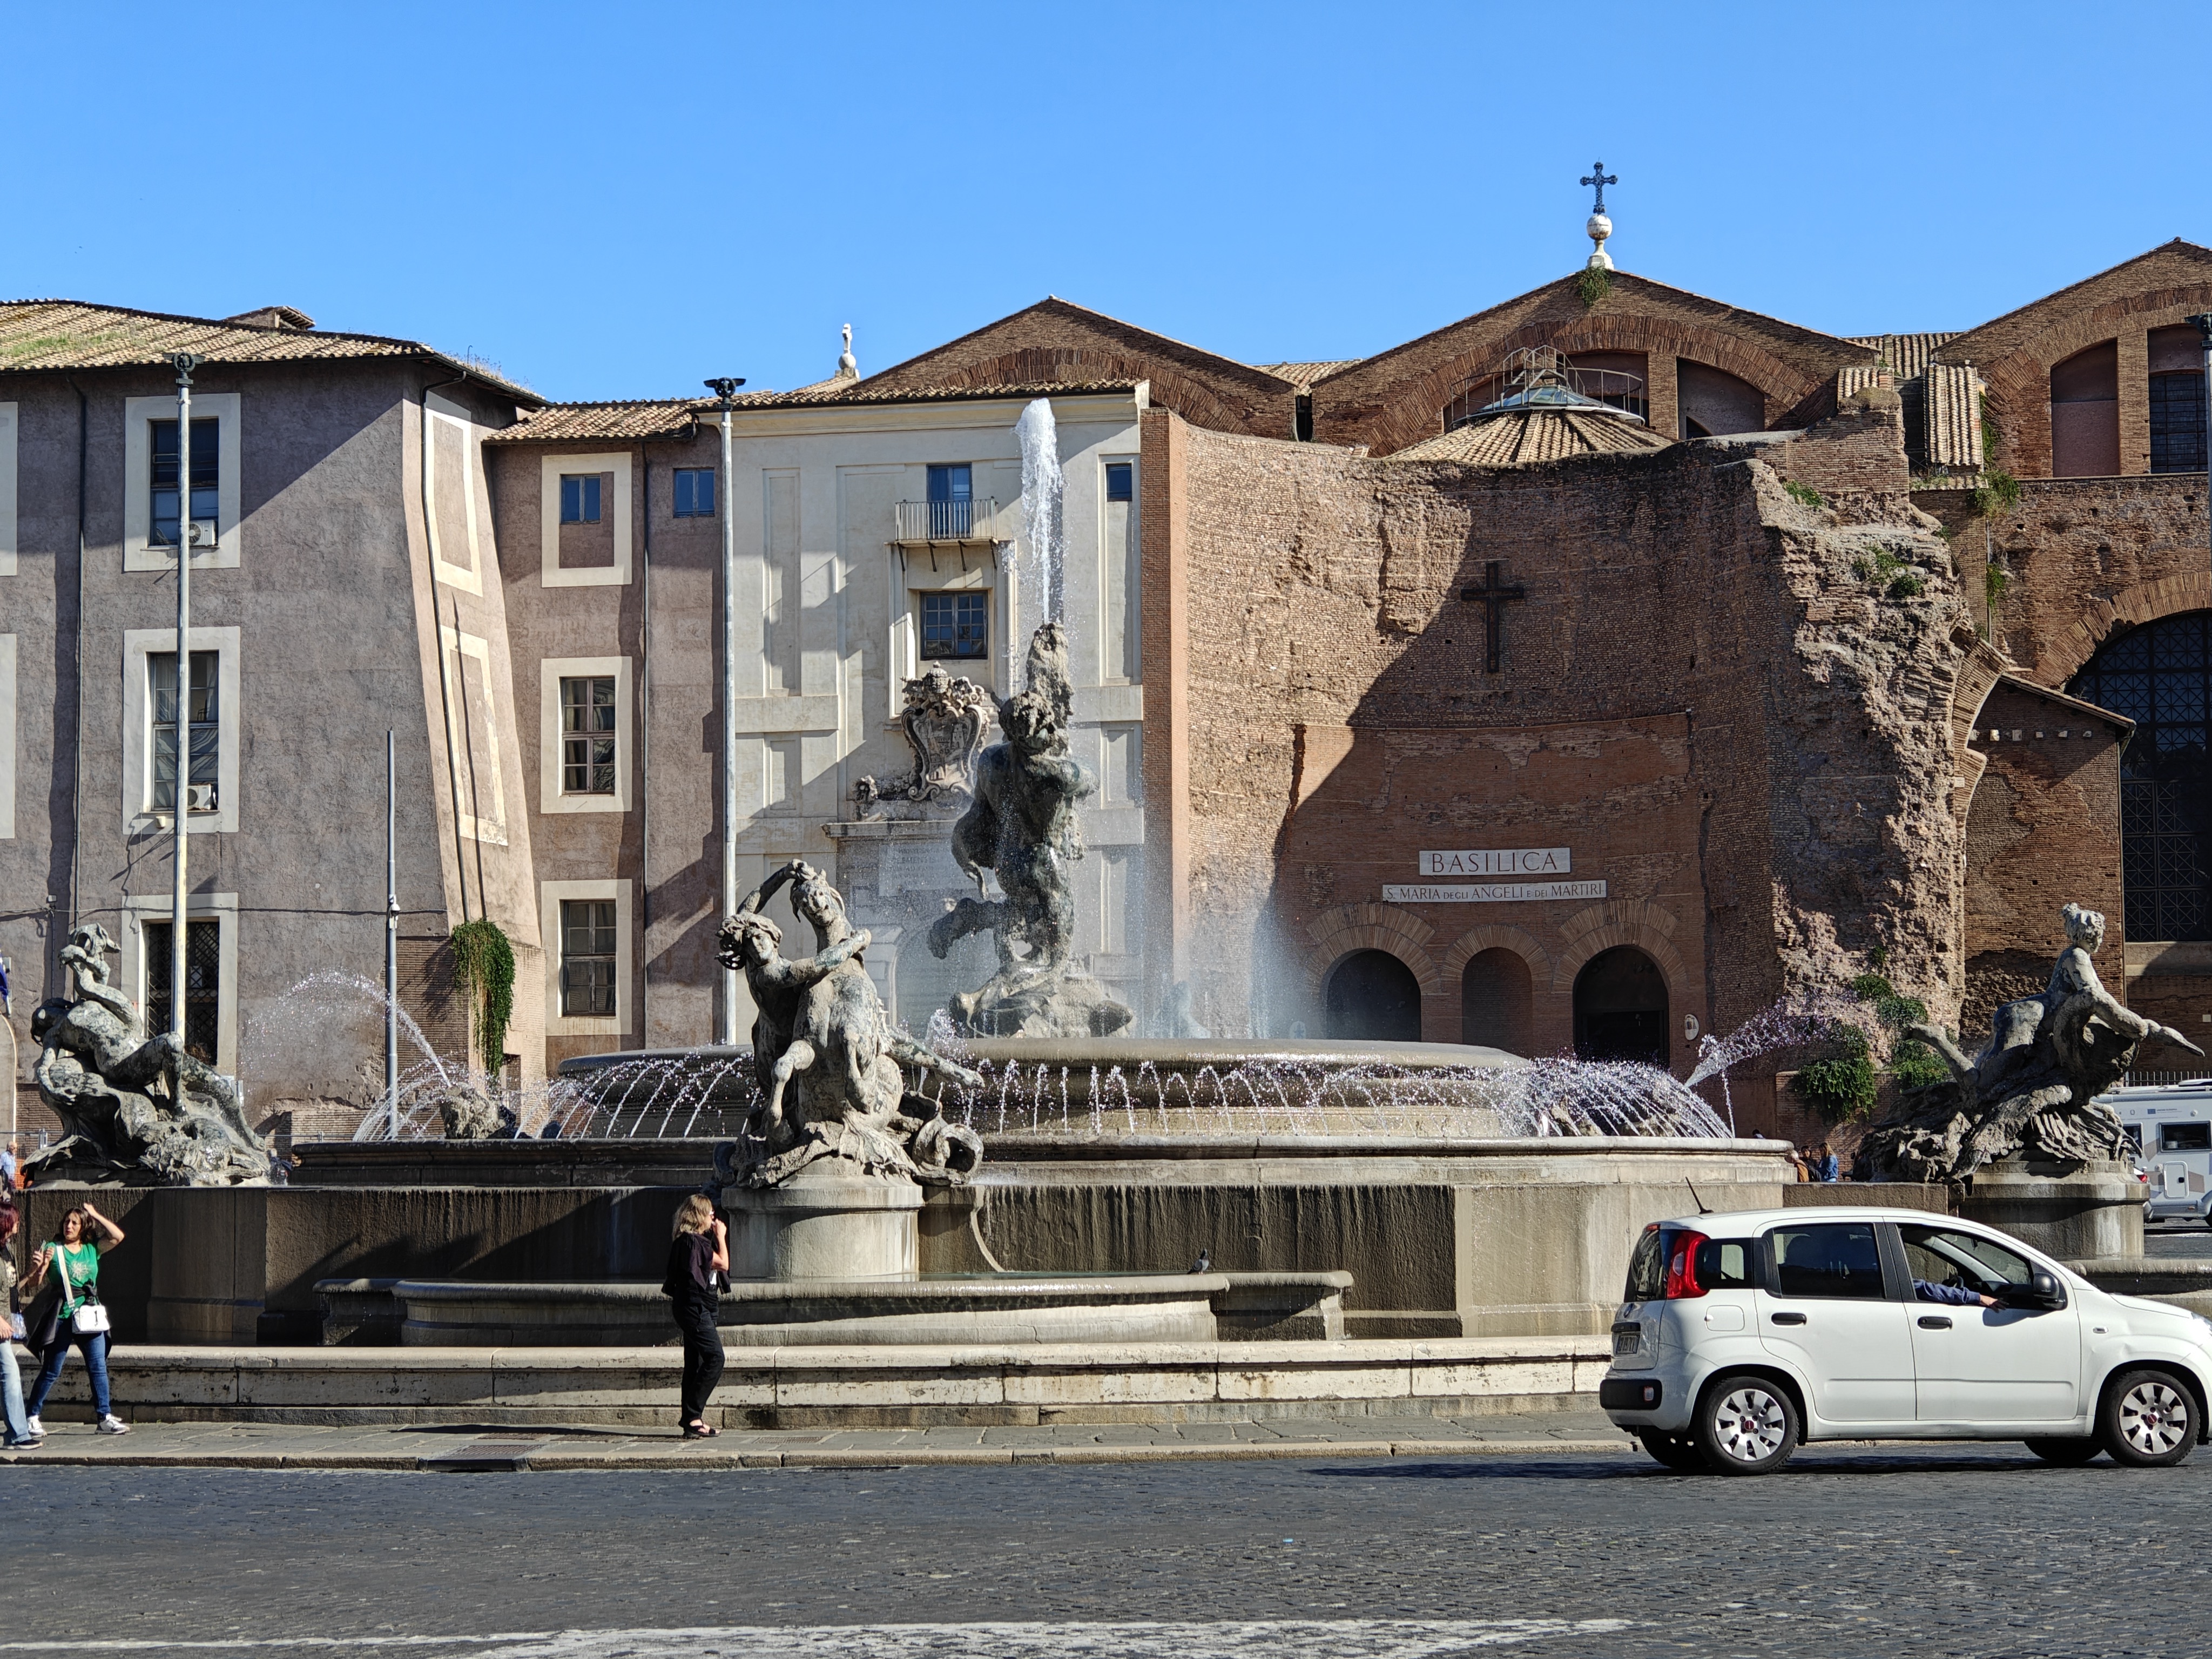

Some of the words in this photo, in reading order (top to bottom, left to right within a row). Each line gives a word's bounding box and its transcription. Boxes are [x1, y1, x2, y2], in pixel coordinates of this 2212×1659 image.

[1432, 852, 1557, 873] BASILICA
[1387, 887, 1396, 899] S.
[1400, 887, 1440, 899] MARIA
[1471, 886, 1523, 899] ANGELI
[1535, 889, 1547, 898] DEI
[1551, 883, 1602, 897] MARTIRI
